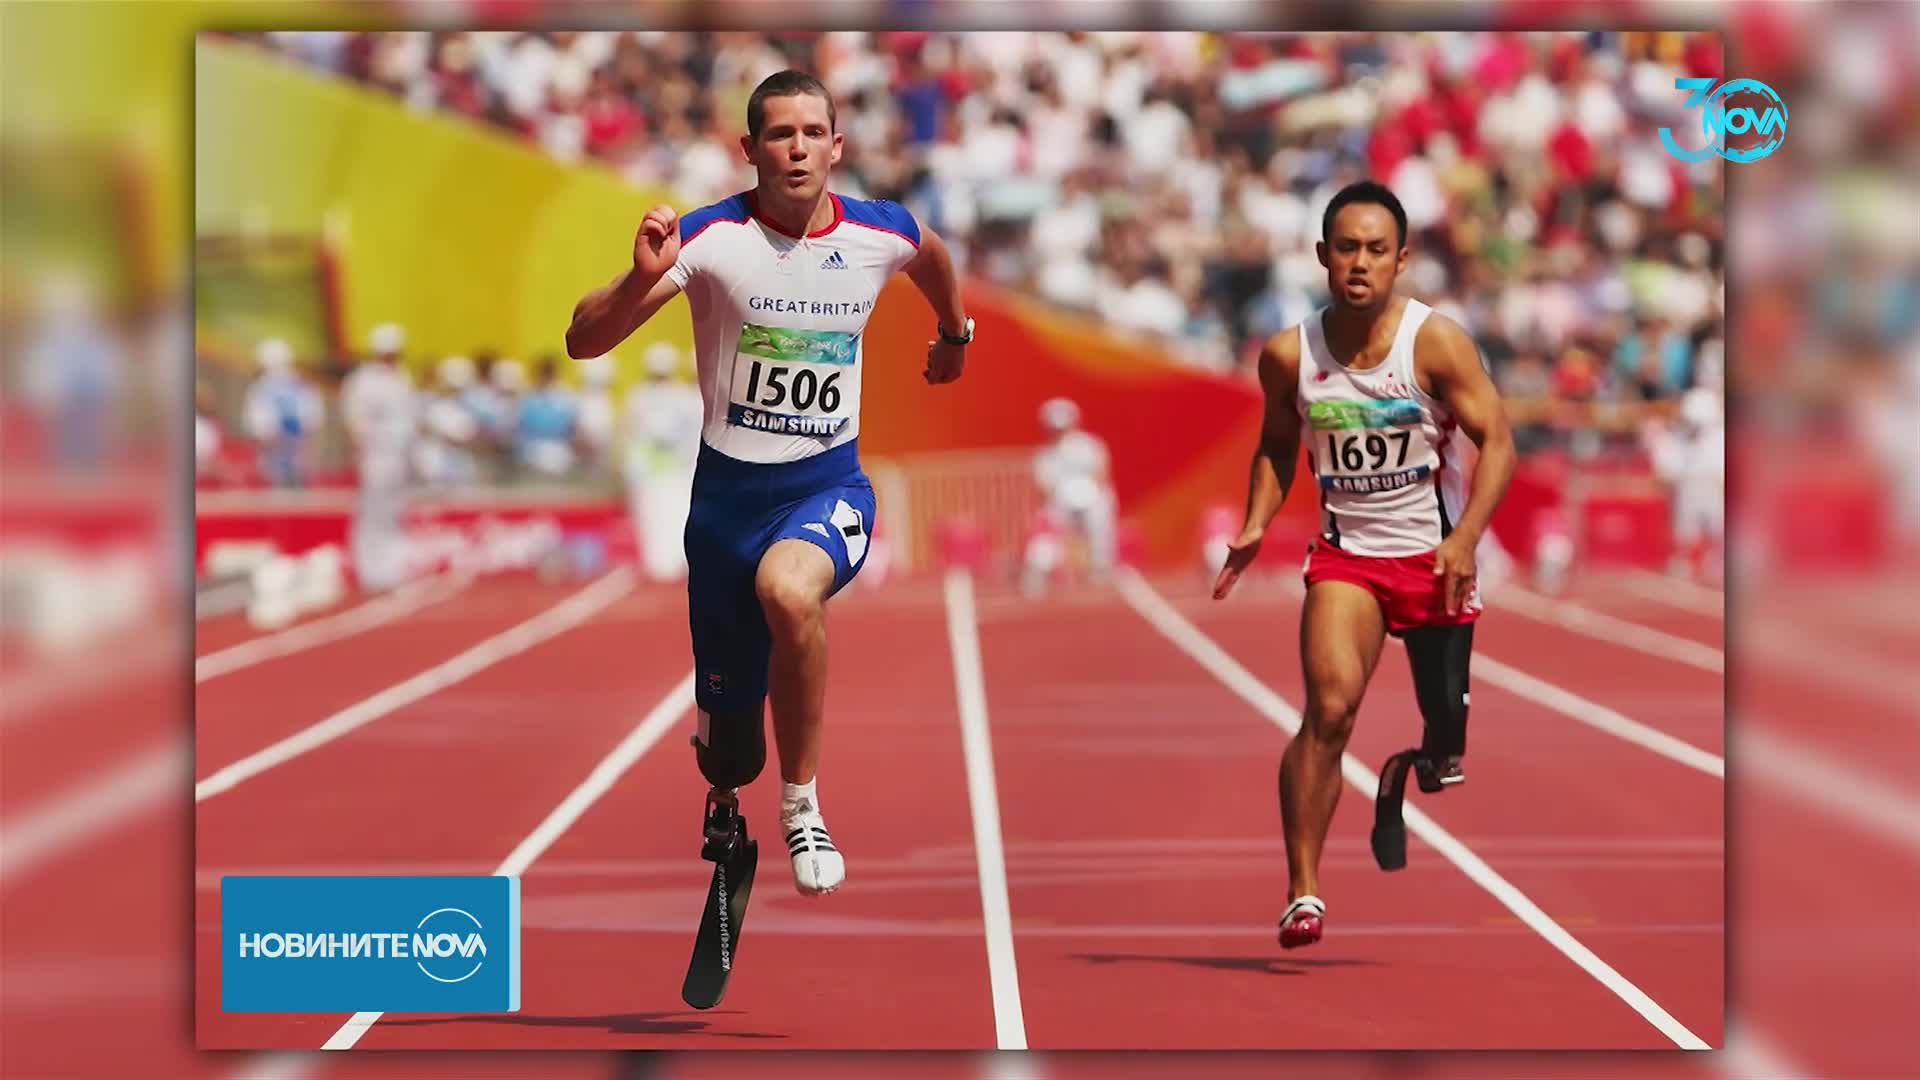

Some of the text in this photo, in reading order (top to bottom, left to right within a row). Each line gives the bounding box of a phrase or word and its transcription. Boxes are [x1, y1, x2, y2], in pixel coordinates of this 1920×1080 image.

[749, 296, 807, 313] GREAT
[746, 360, 841, 414] 1506
[1328, 431, 1411, 471] 1697
